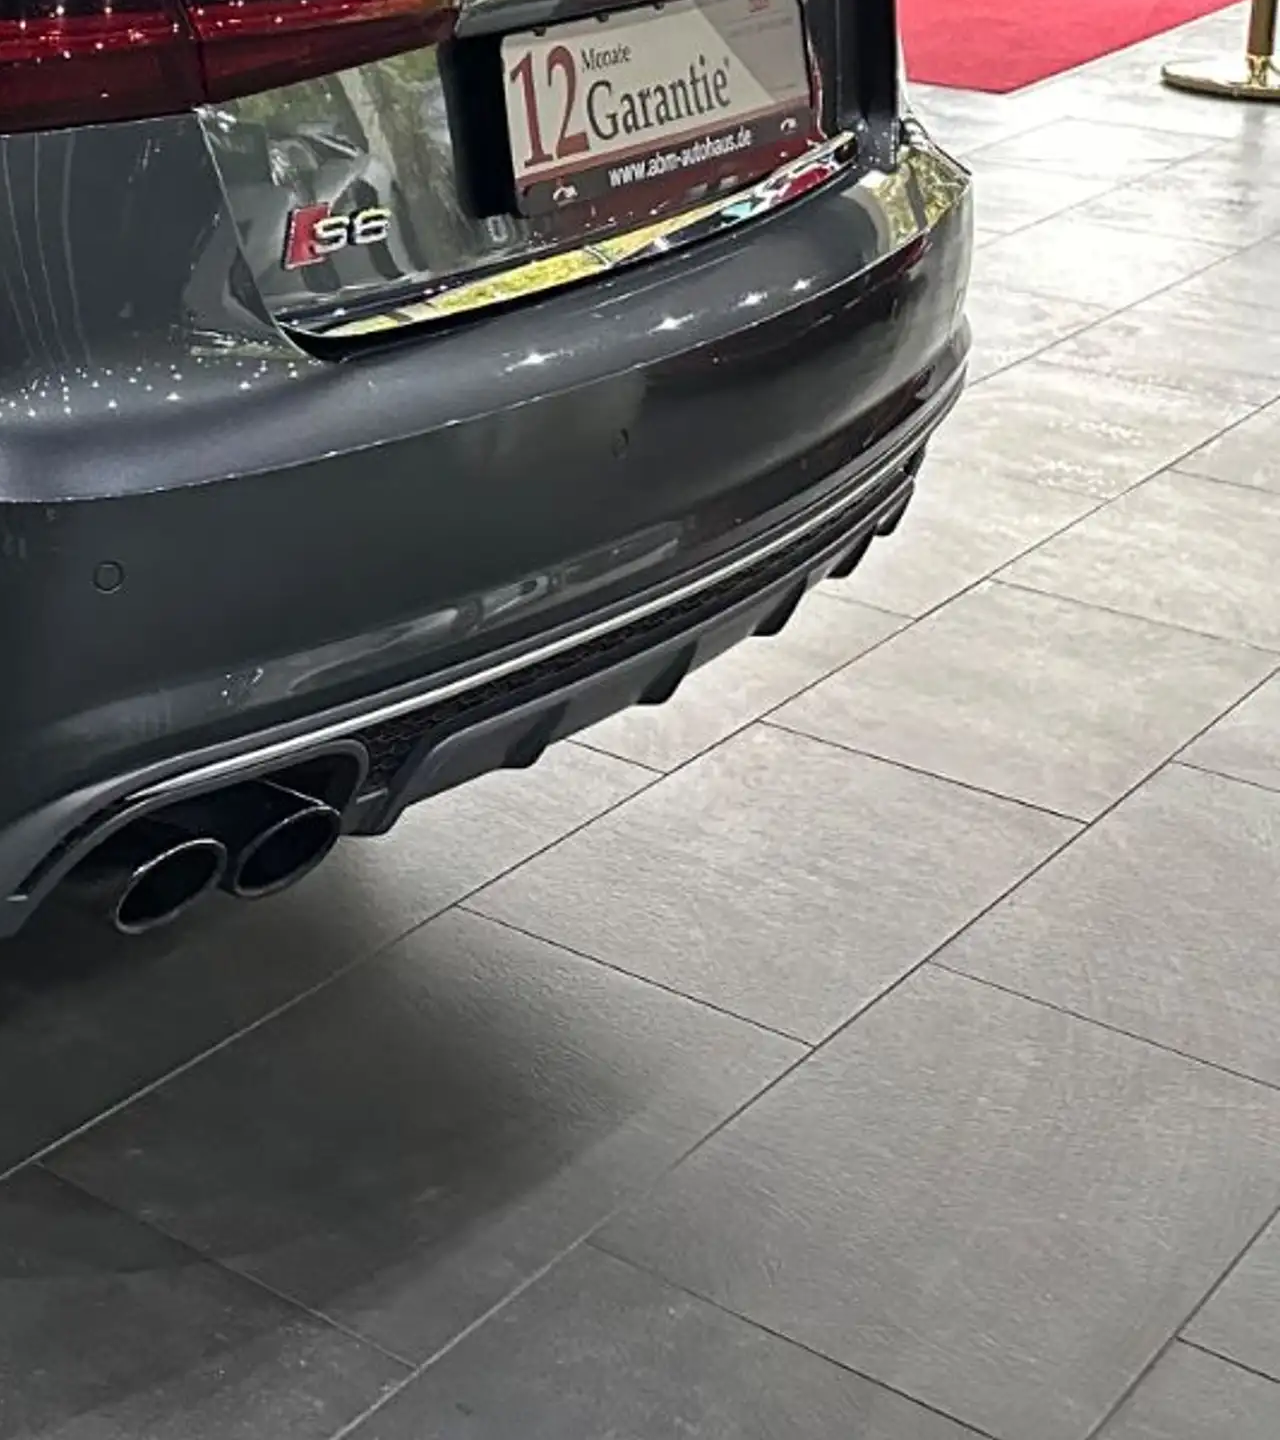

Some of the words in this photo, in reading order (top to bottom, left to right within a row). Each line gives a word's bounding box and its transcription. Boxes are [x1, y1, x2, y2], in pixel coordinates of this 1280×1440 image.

[510, 45, 590, 169] 12
[581, 42, 632, 73] Monate
[608, 125, 752, 187] www.abm-autohaus.de
[313, 207, 392, 254] S6
